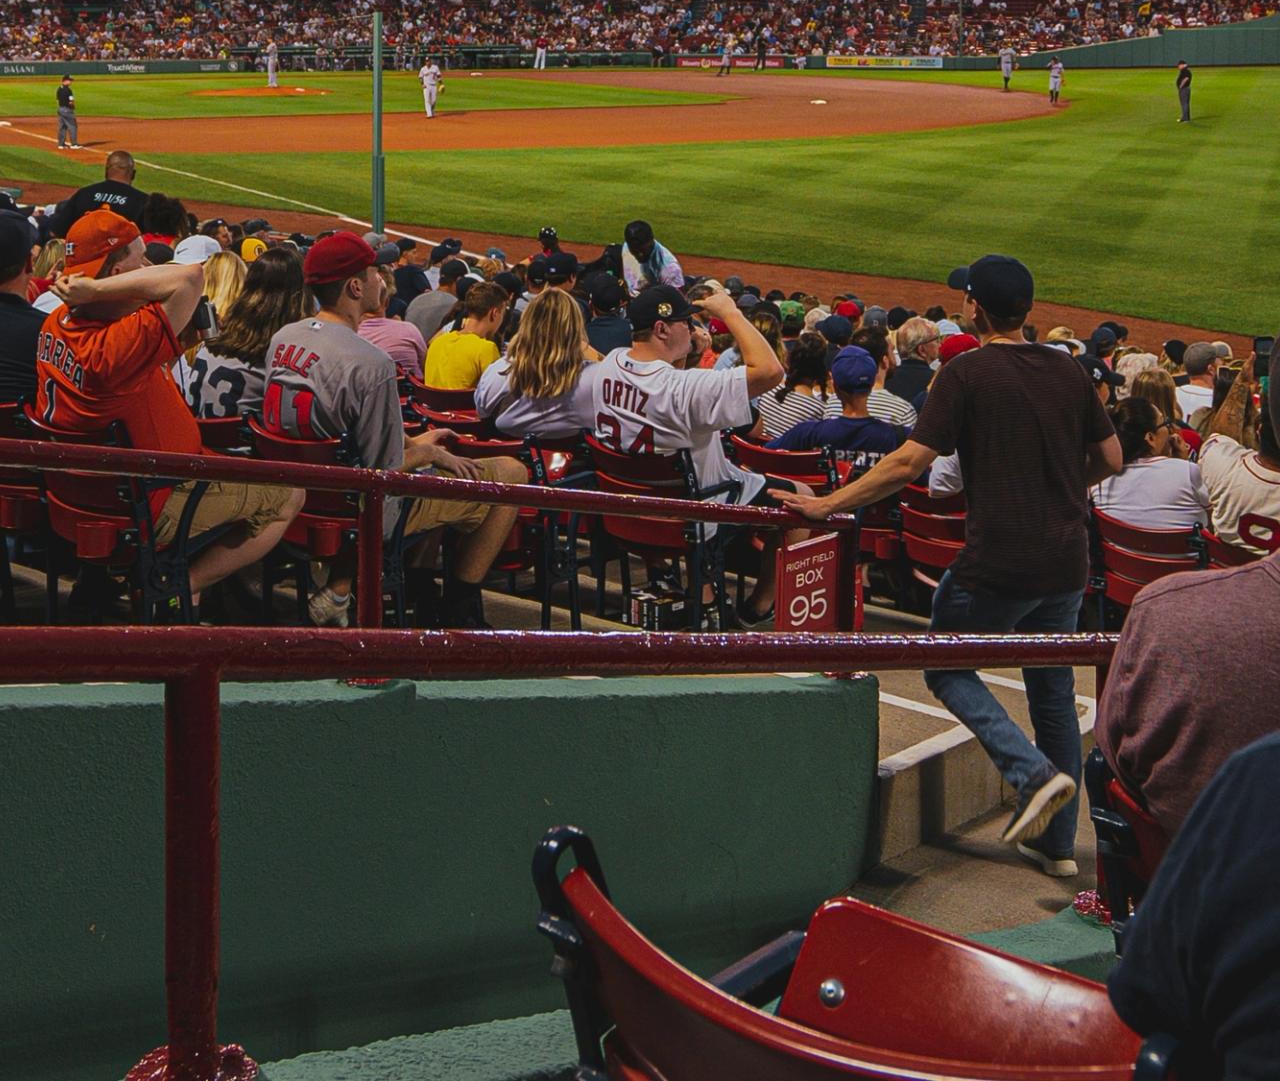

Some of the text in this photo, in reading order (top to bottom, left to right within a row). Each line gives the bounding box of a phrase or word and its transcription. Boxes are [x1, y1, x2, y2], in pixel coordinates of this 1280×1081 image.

[3, 65, 35, 73] DASANI
[94, 192, 128, 206] 9/11/56
[272, 343, 320, 378] SALE
[44, 377, 56, 423] 1
[263, 381, 314, 438] 41
[602, 377, 649, 418] ORTIZ
[786, 550, 835, 573] RIGHT FIELD
[795, 567, 824, 588] BOX
[789, 588, 828, 626] 95
